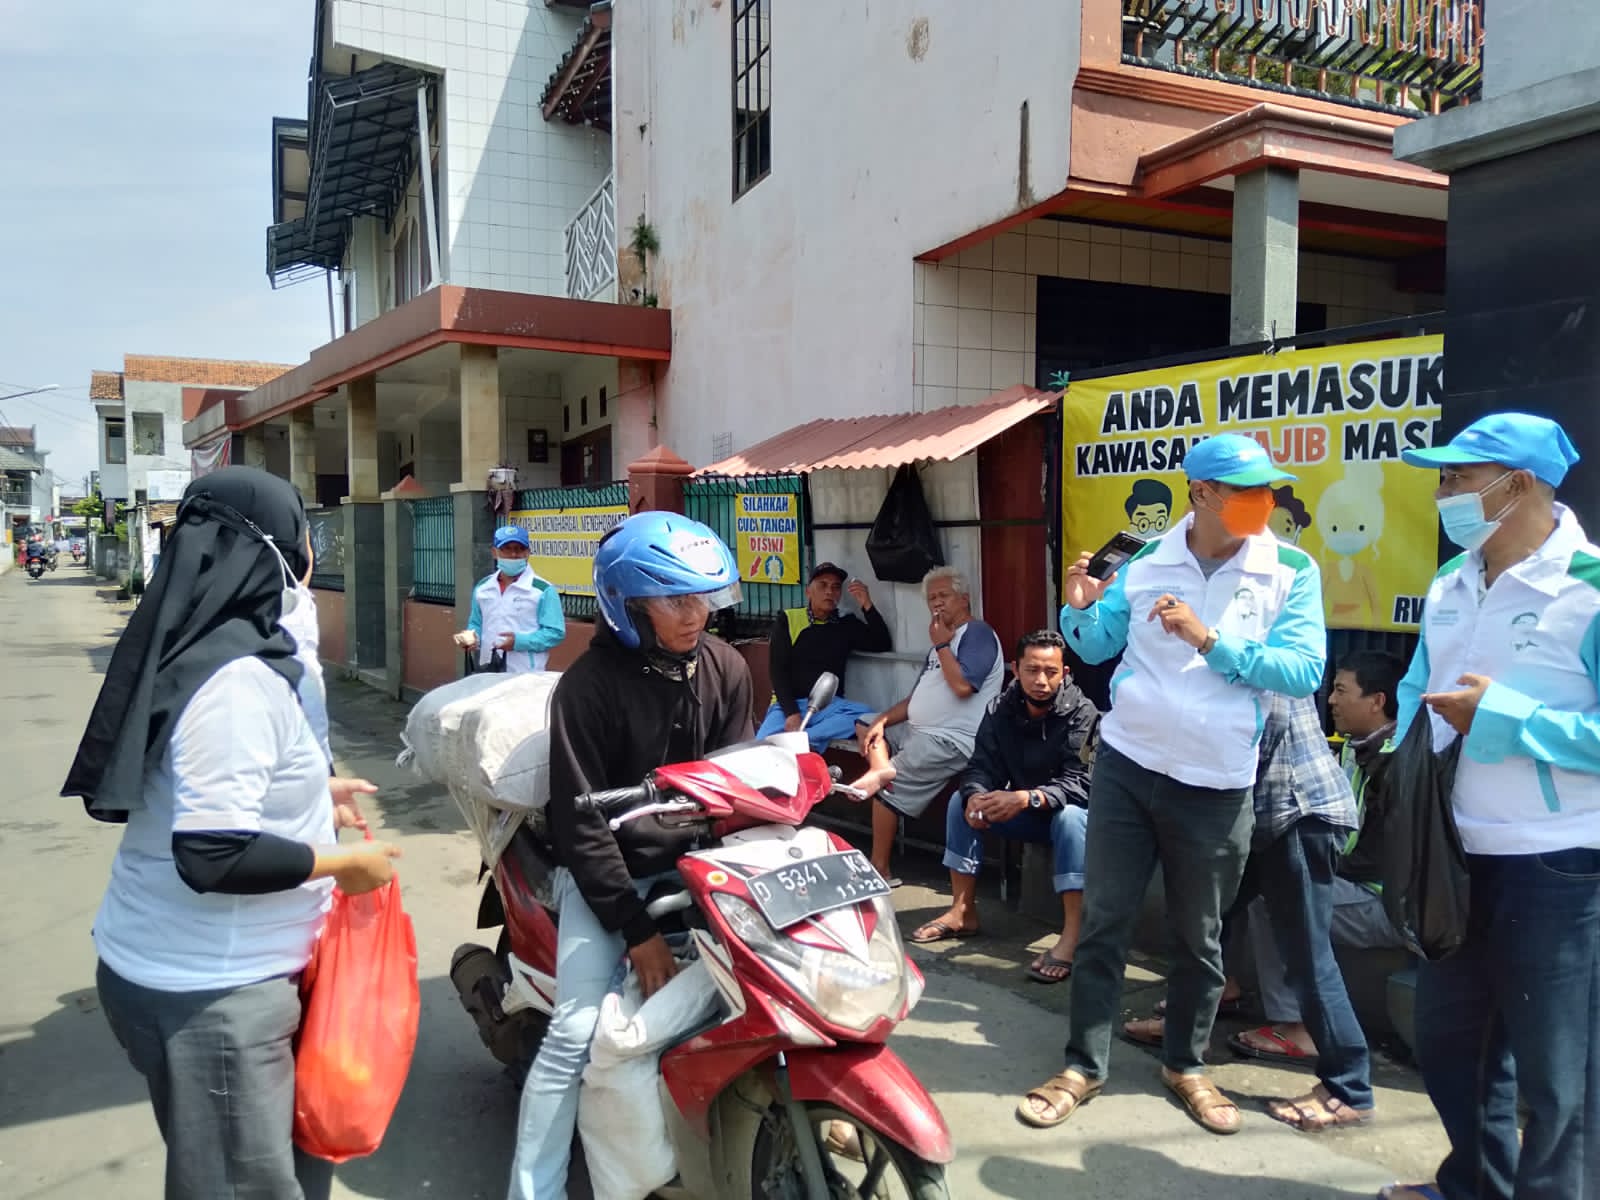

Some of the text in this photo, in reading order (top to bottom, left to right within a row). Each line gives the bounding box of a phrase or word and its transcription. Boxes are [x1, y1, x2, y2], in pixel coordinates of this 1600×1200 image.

[1102, 355, 1442, 433] ANDA MEMASUK
[1076, 437, 1207, 476] KAWASA
[1240, 427, 1327, 464] AJIB
[743, 496, 788, 512] SILAHKAN
[738, 518, 797, 533] CUCI TANGAN
[750, 537, 784, 553] DISINI
[753, 881, 772, 903] D
[776, 862, 828, 891] 5341
